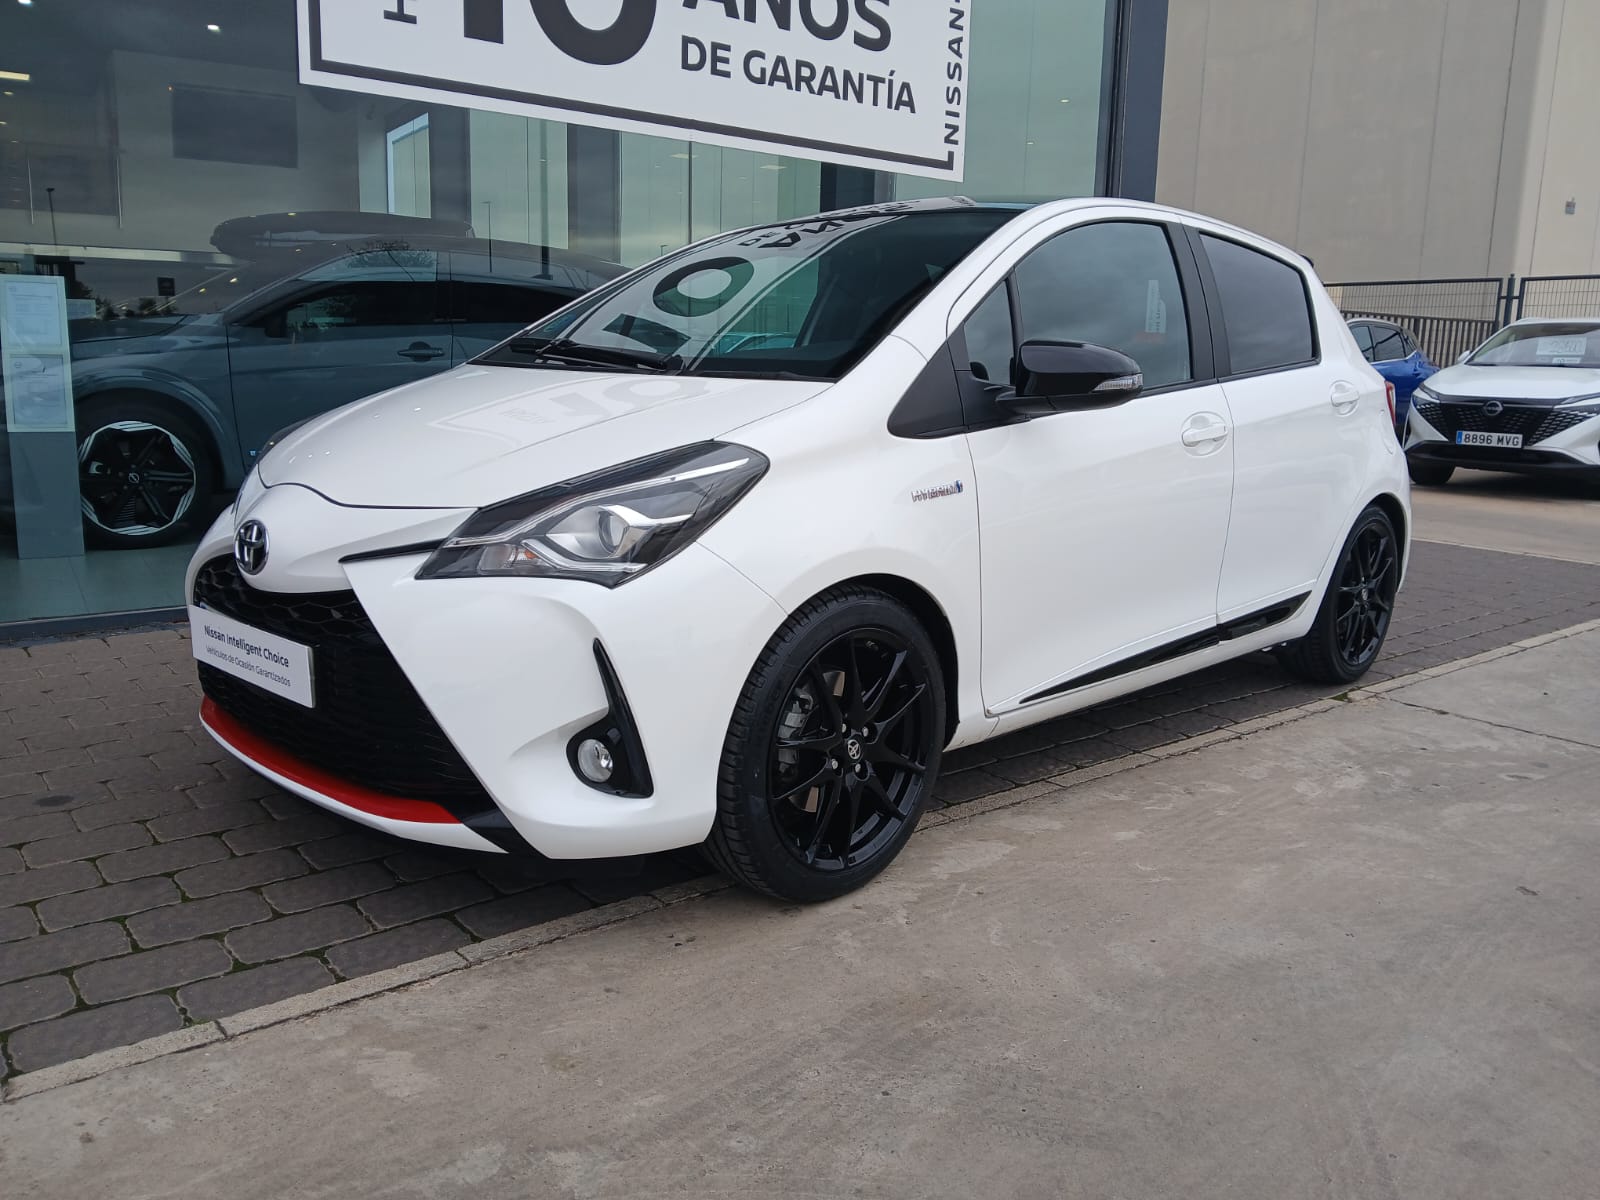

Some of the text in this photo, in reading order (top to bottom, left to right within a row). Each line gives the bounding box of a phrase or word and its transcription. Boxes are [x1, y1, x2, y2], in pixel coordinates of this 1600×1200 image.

[682, 0, 891, 52] OS
[681, 34, 916, 114] DE GARANTÍA
[944, 7, 965, 146] NISSAN
[1463, 433, 1519, 447] 8896 MVG
[204, 625, 289, 668] Nissan Intelligent Choice
